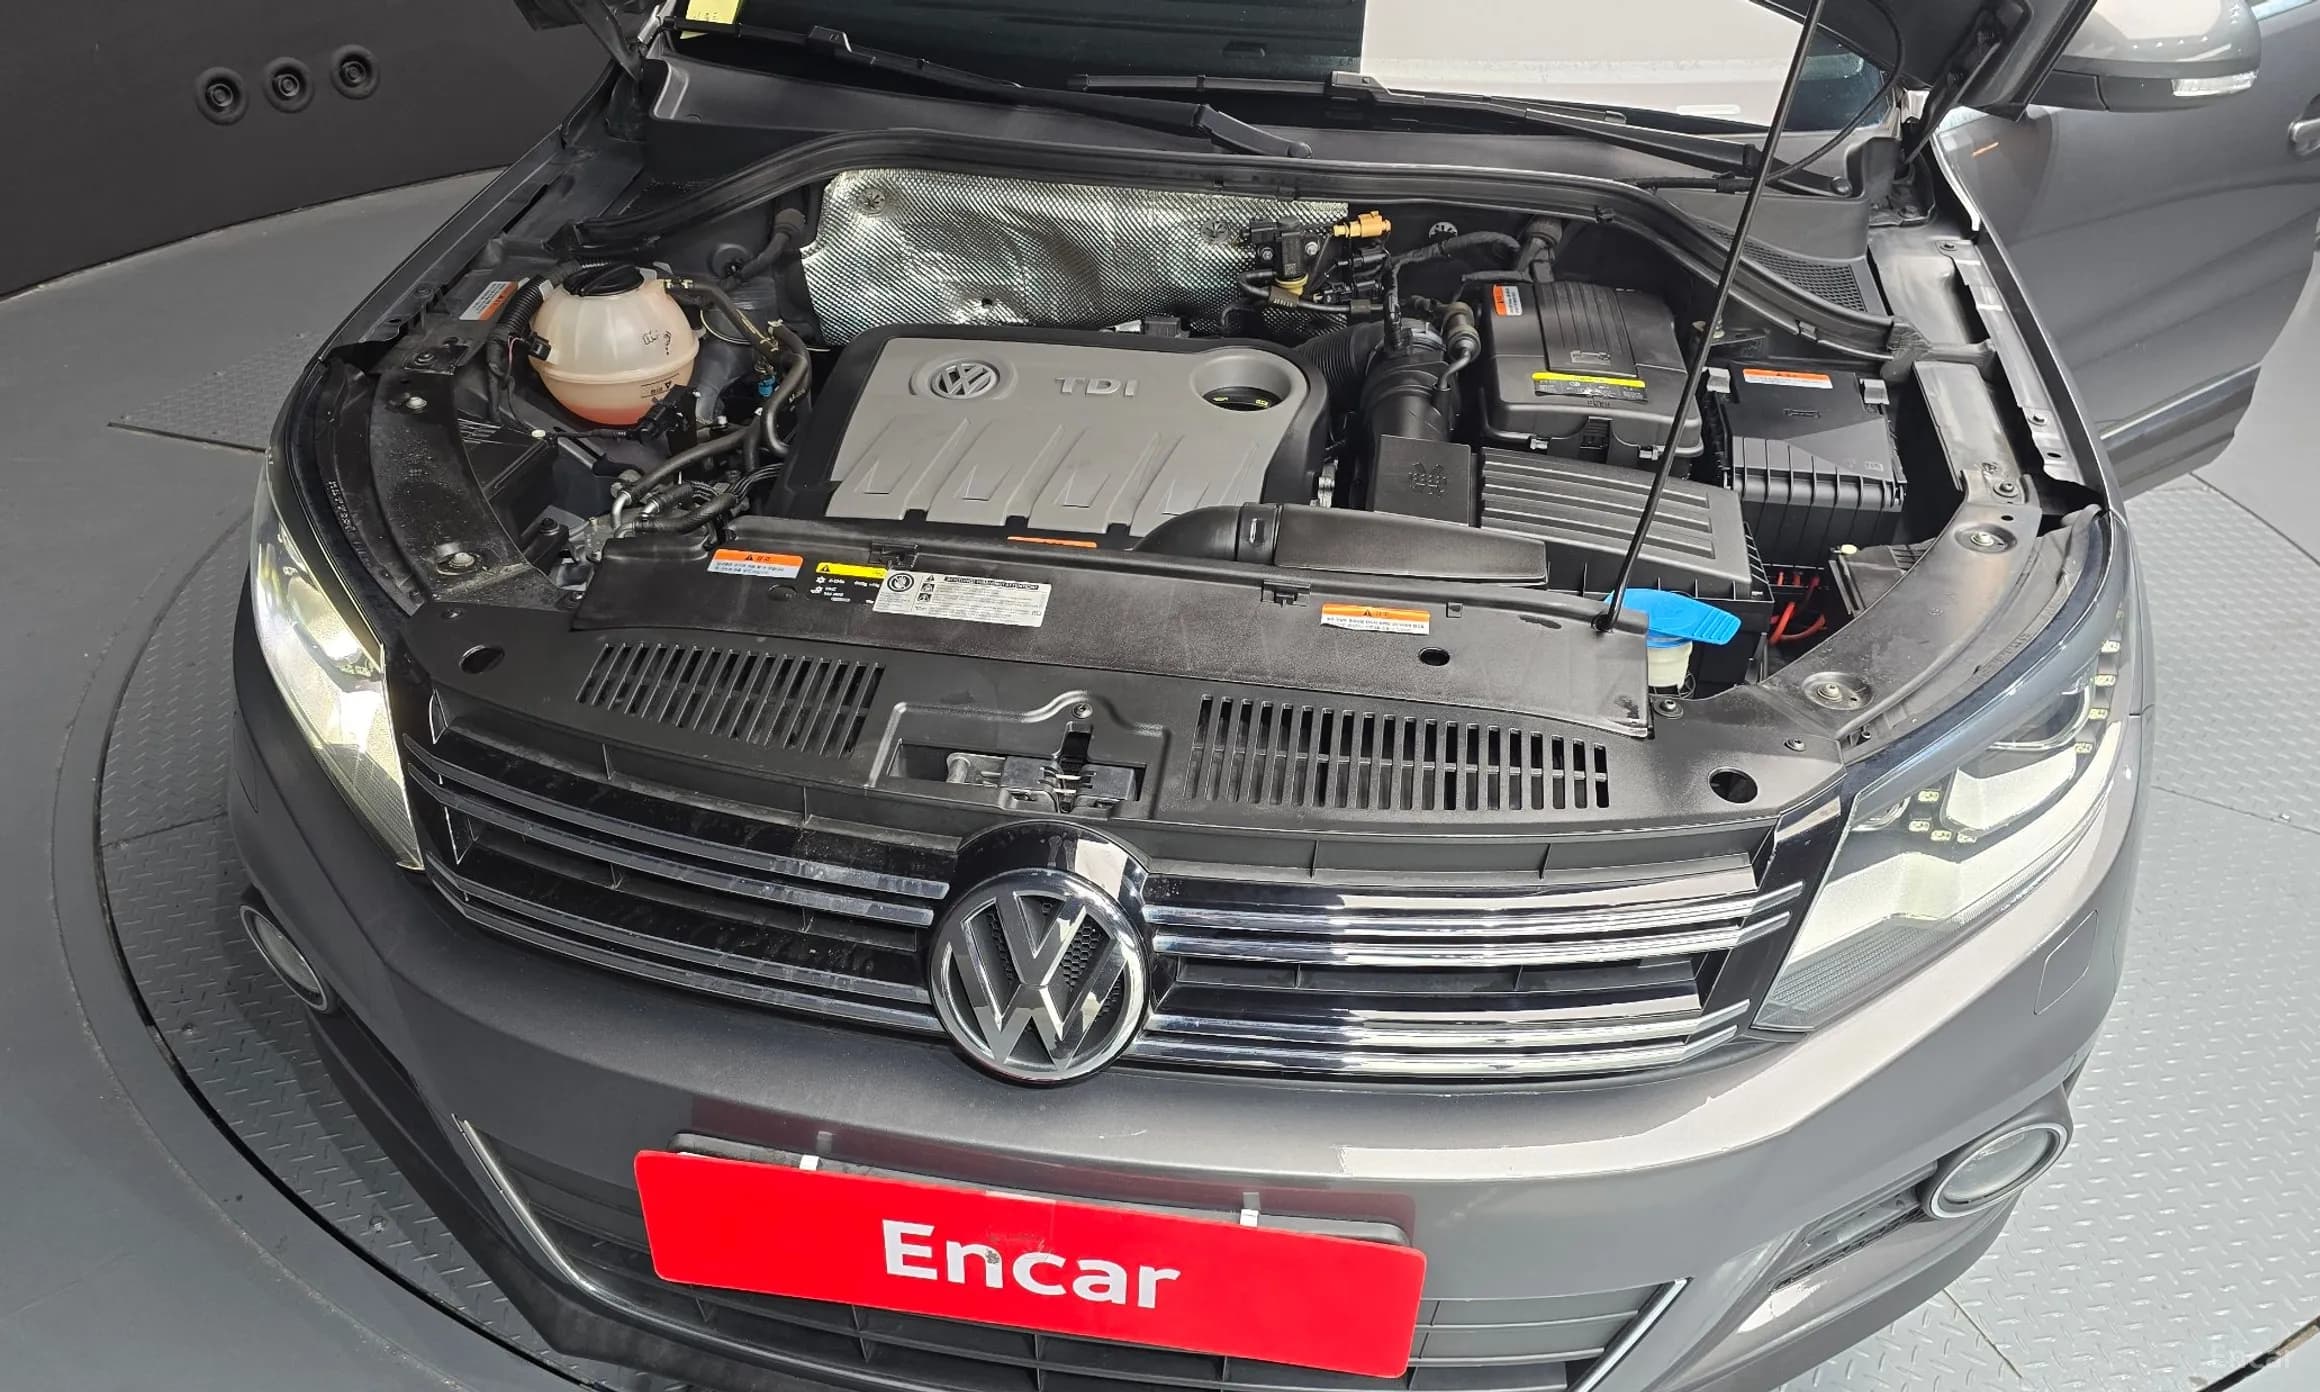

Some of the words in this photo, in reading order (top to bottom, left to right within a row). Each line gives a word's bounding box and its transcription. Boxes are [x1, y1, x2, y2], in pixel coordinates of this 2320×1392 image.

[1055, 376, 1137, 398] TDI
[936, 873, 1144, 1082] VW
[882, 1219, 1181, 1309] Encar
